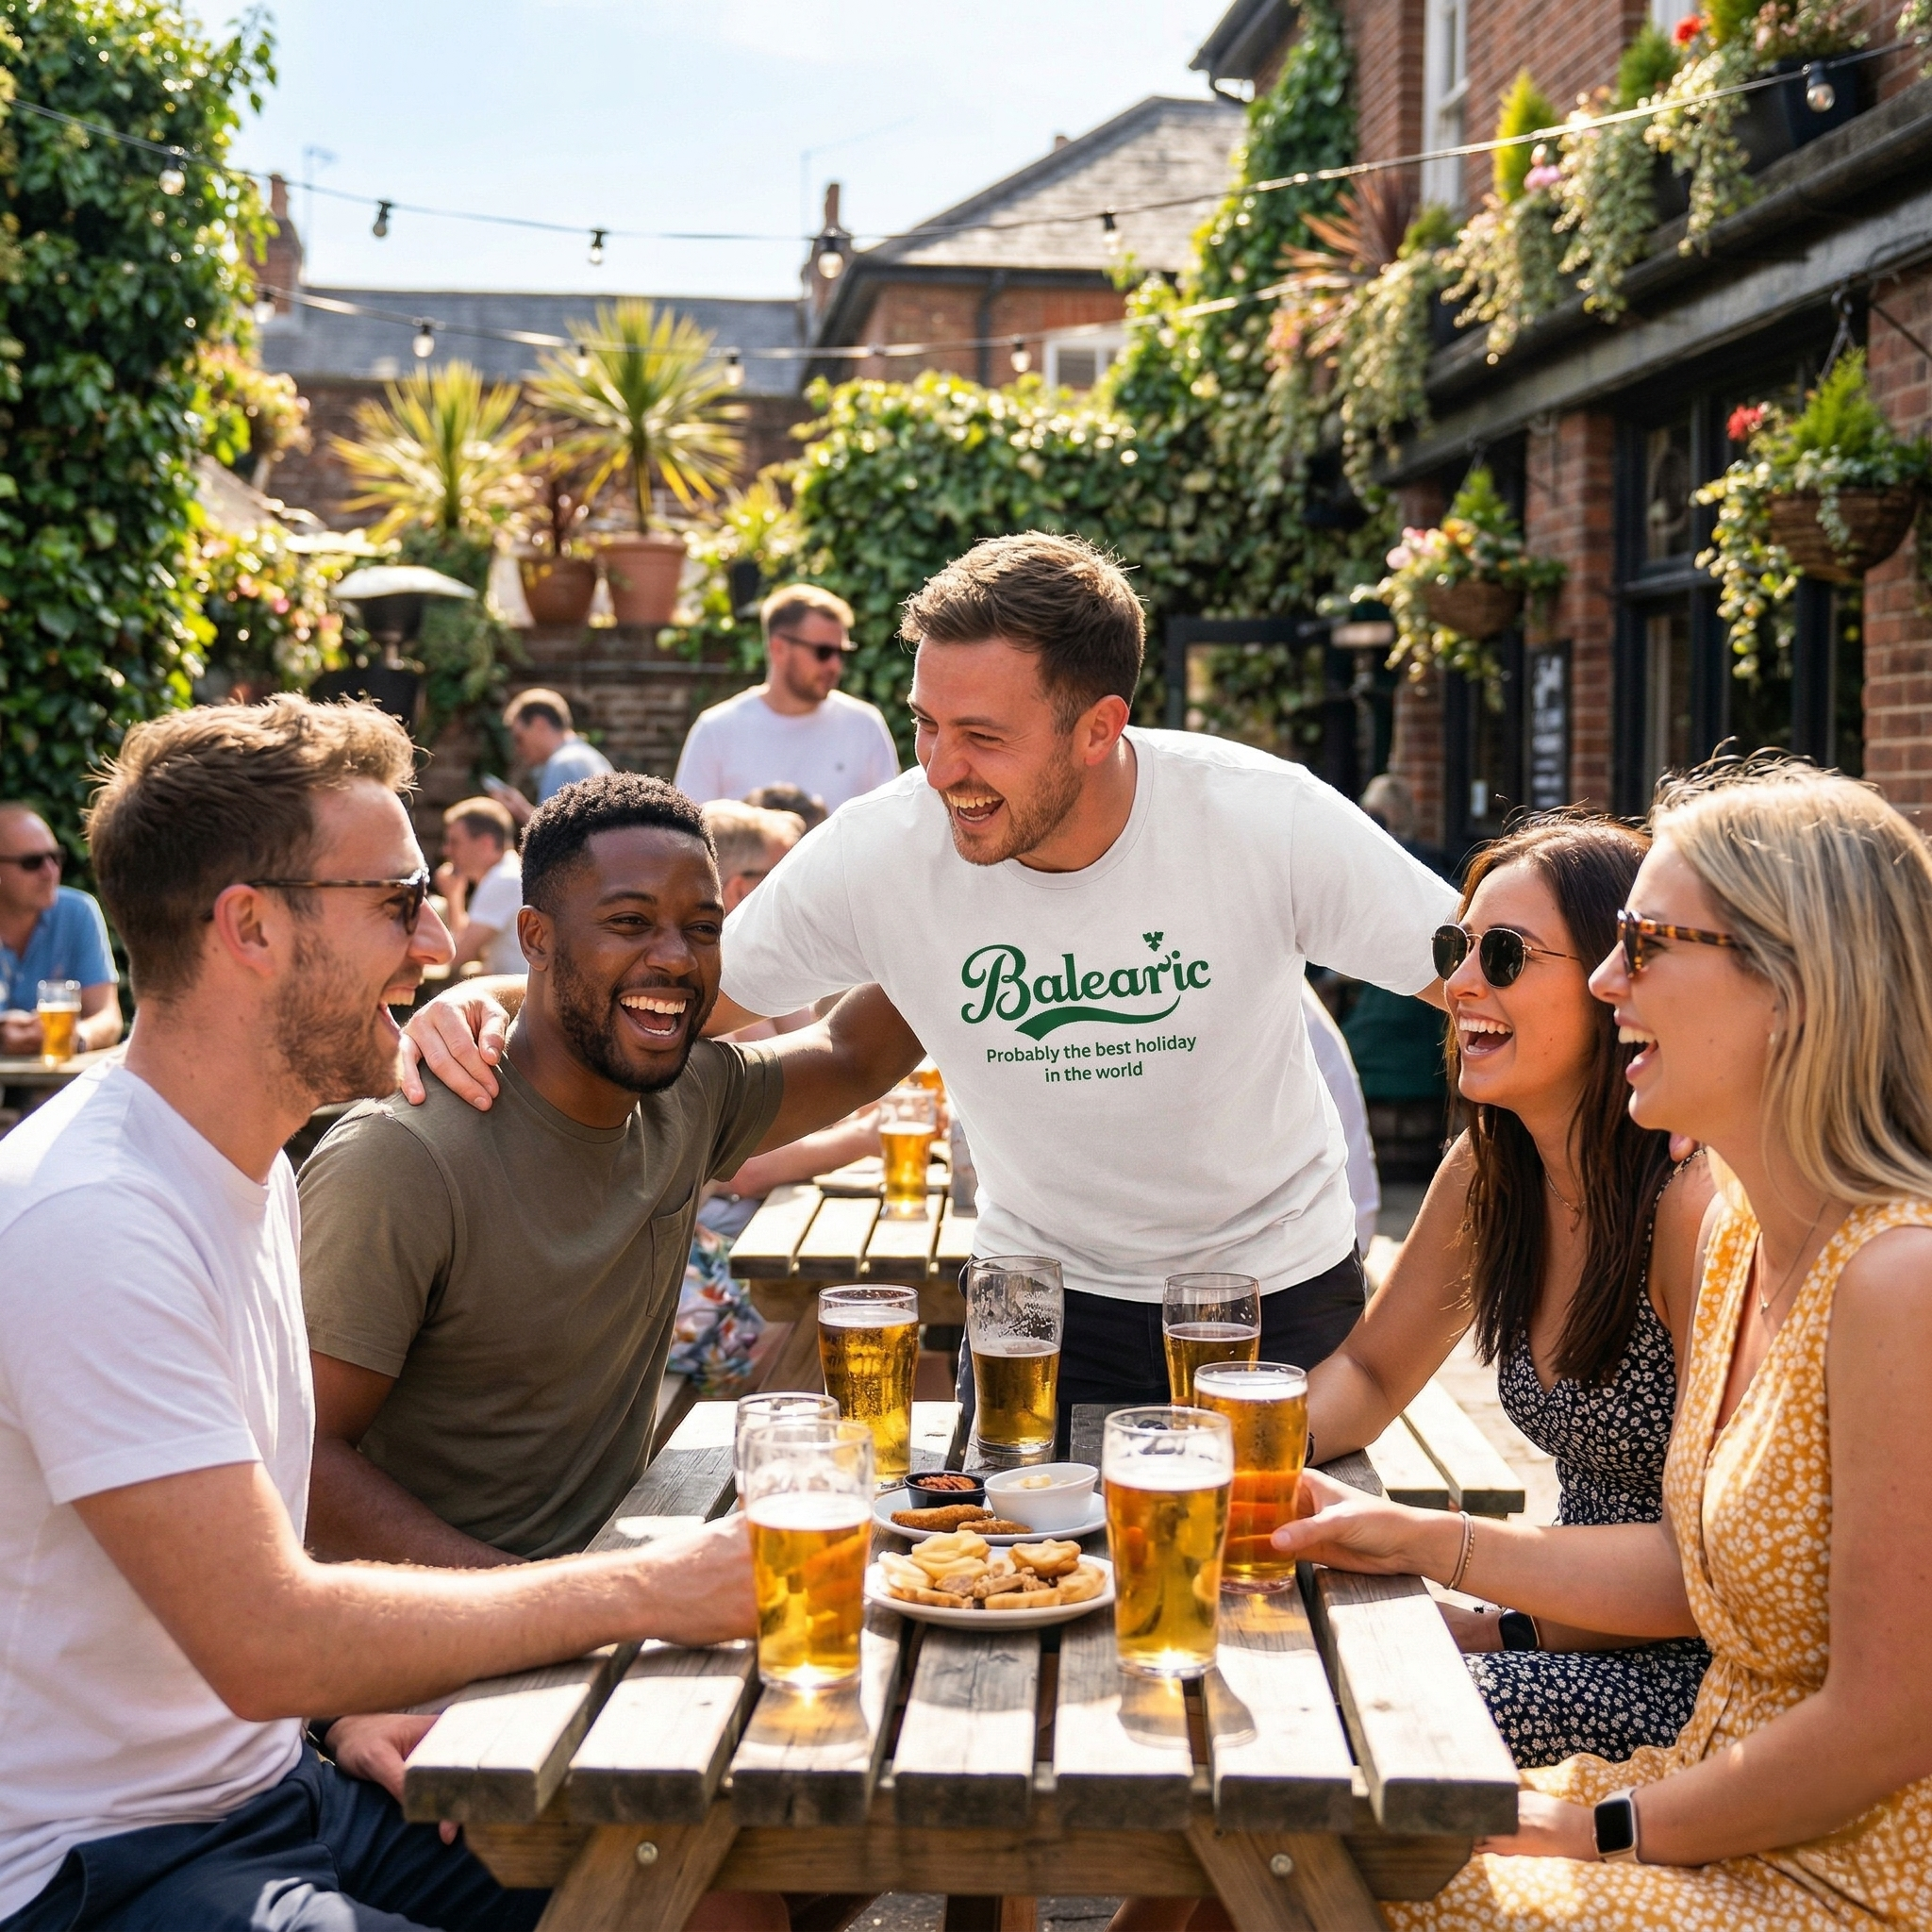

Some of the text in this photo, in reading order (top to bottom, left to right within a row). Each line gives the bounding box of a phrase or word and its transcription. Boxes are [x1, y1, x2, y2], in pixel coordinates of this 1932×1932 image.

[961, 944, 1211, 1024] Balearic
[987, 1035, 1197, 1063] Probably the best holiday
[1045, 1061, 1143, 1082] in the world
